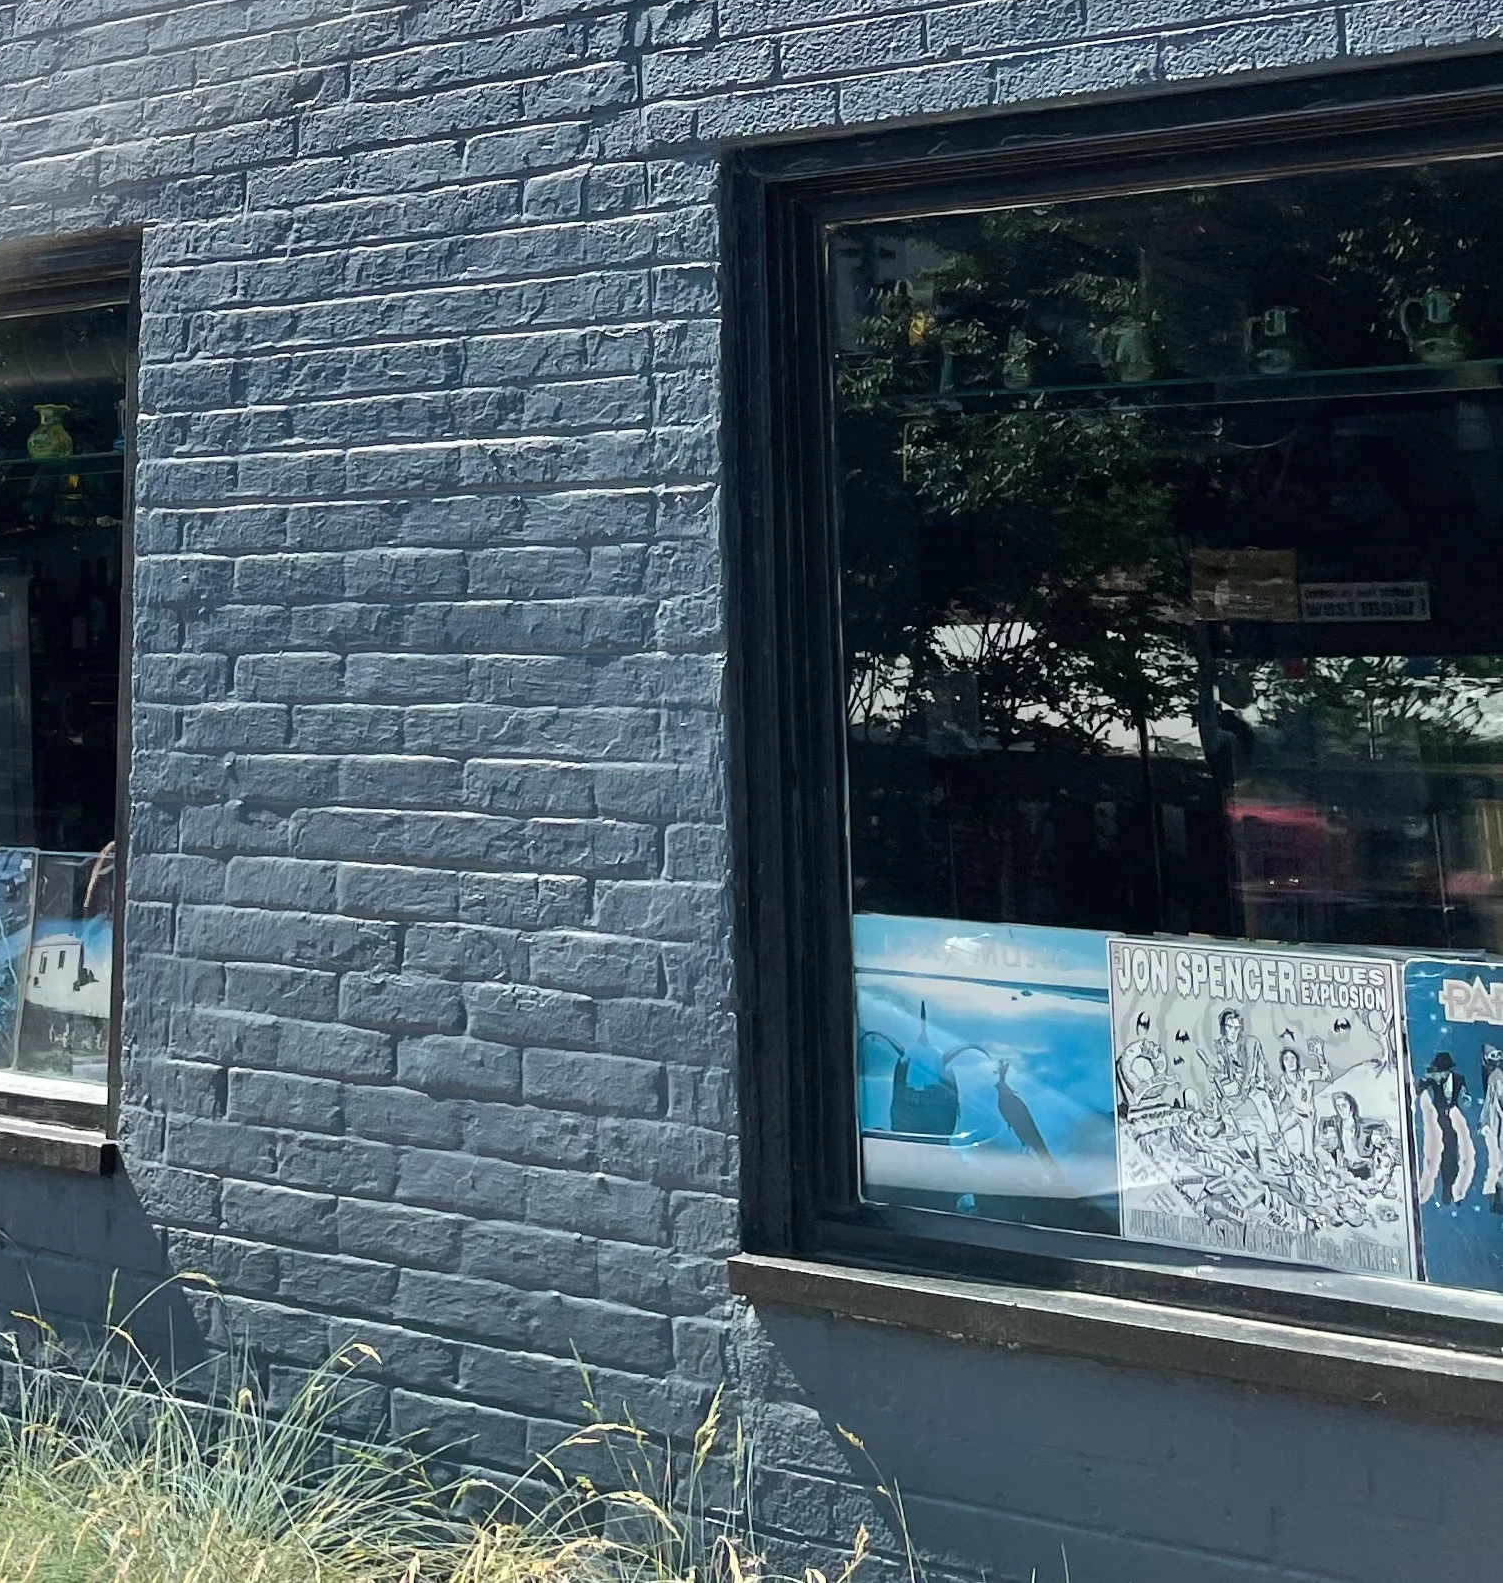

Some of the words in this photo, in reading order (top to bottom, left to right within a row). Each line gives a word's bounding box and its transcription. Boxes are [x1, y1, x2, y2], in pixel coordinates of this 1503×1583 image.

[1117, 946, 1169, 996] JON
[1174, 951, 1298, 1007] SPENCER
[1300, 963, 1385, 986] BLUES
[1300, 981, 1387, 1012] EXPLOSION
[1130, 1208, 1181, 1241] JUKEBOX
